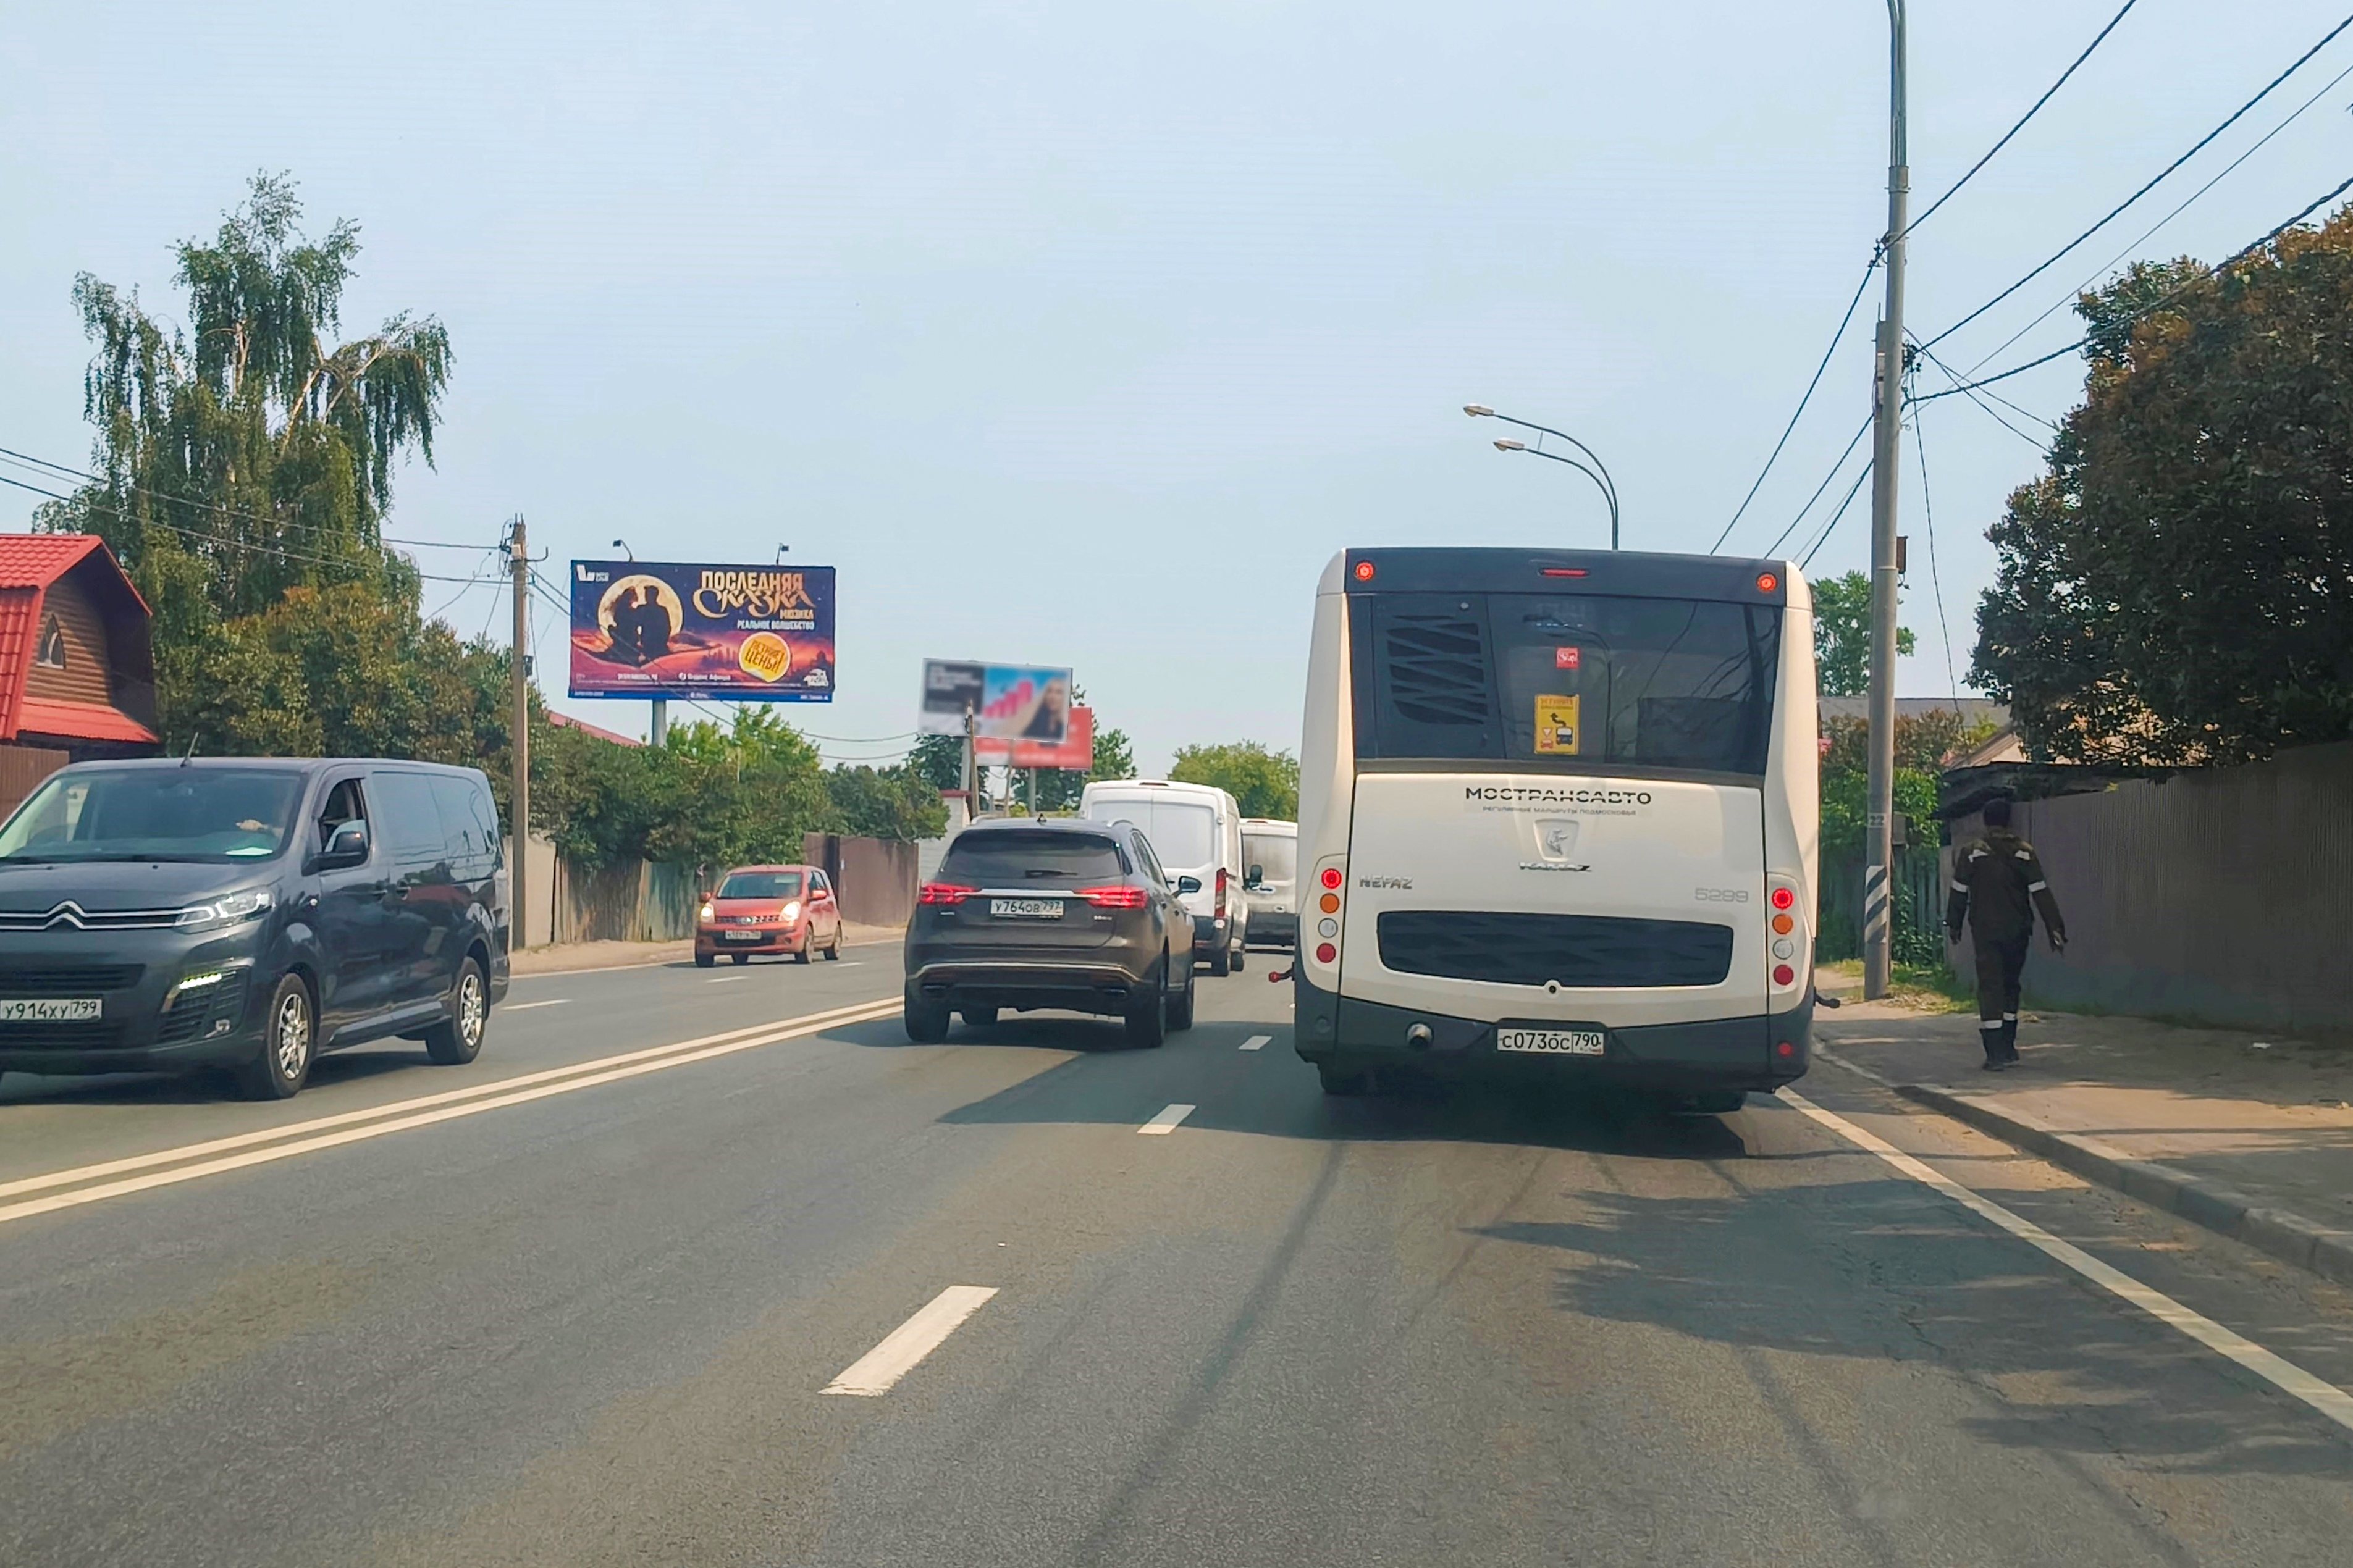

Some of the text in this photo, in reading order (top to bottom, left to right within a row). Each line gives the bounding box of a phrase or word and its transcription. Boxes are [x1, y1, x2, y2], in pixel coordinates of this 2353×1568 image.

[701, 571, 803, 592] ПОСЛЕДНЯЯ
[1465, 787, 1652, 805] МОСТРАНСАВТО
[1359, 875, 1413, 890] NEFAZ
[1502, 1032, 1599, 1050] С073ОС 790
